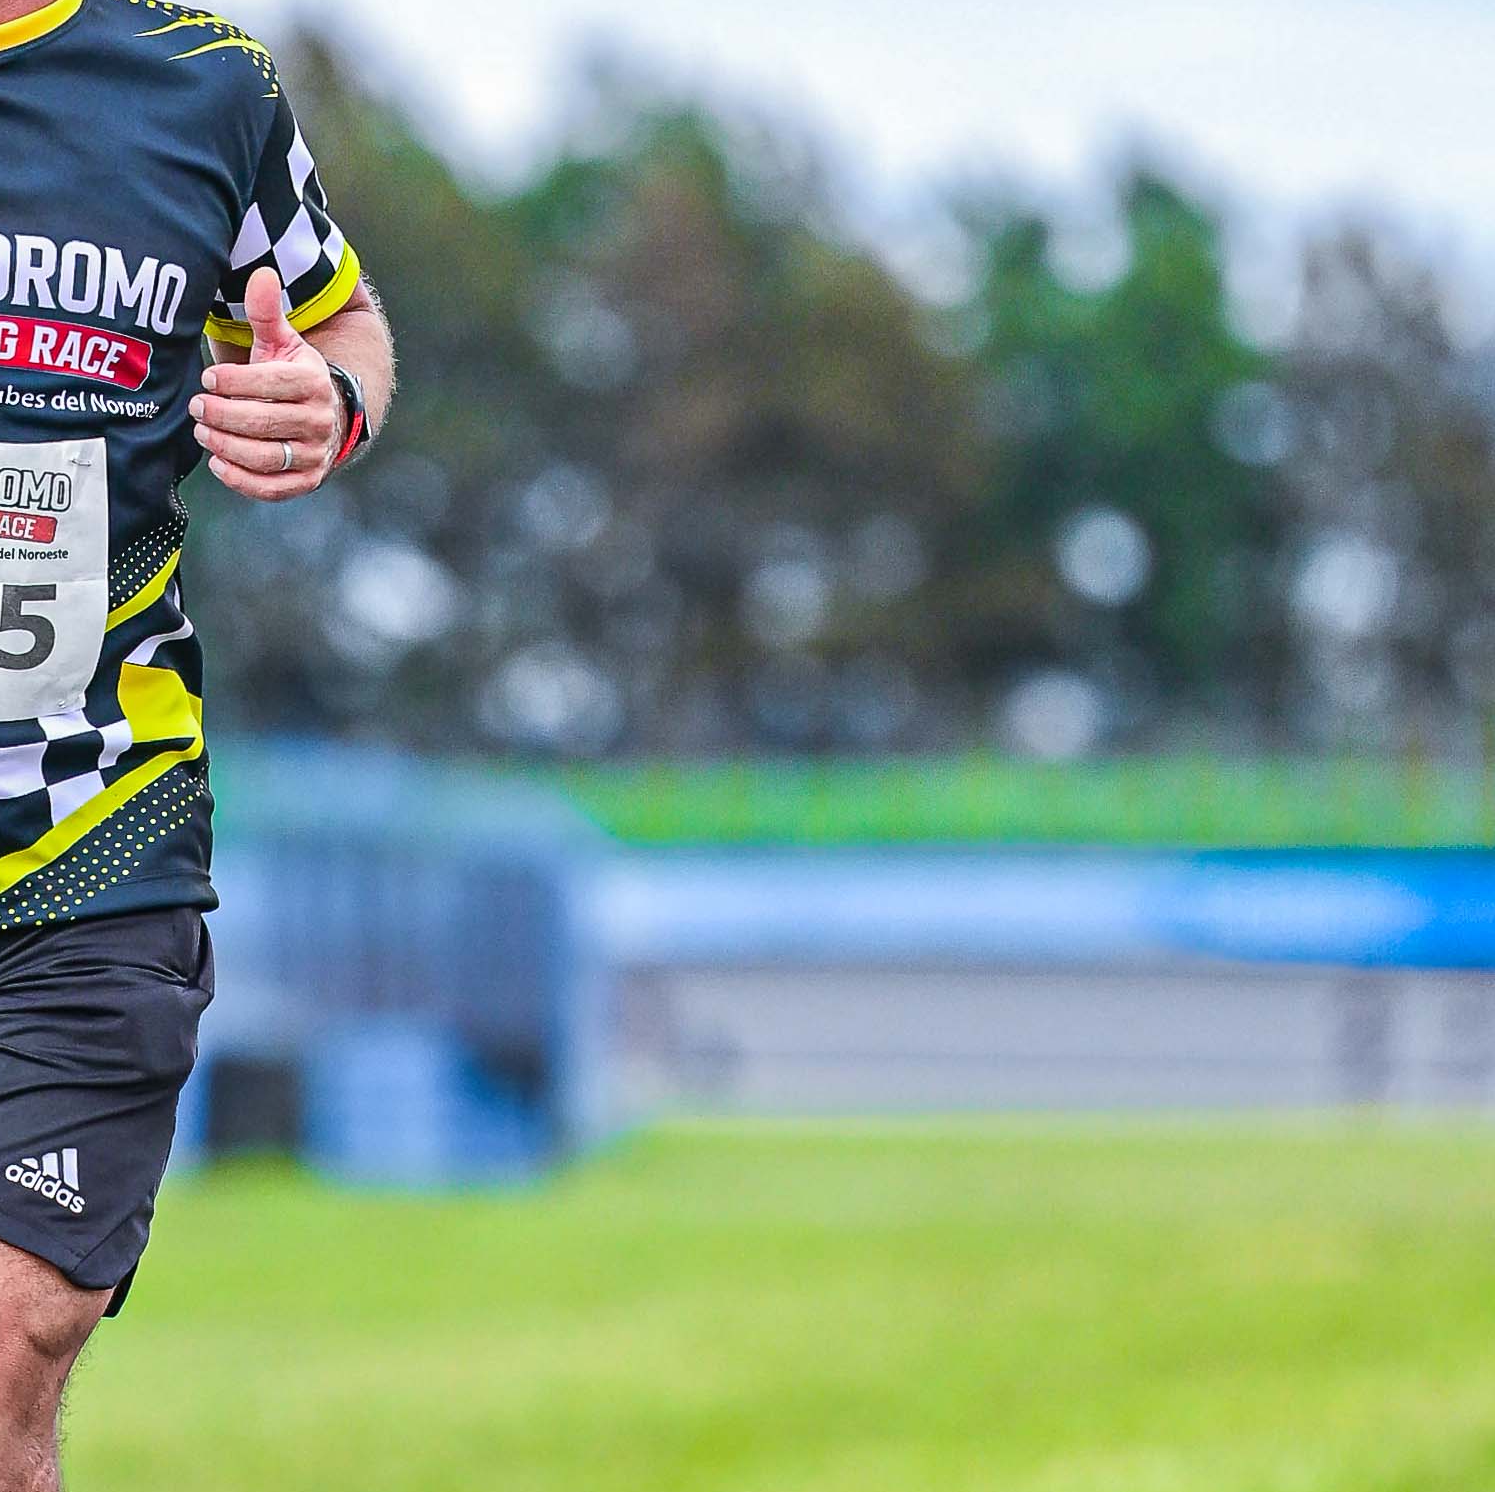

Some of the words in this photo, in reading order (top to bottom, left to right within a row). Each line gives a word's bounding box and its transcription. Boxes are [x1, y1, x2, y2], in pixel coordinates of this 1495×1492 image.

[28, 324, 128, 379] RACE
[50, 390, 86, 412] del
[18, 548, 69, 561] Noroeste
[5, 1164, 85, 1214] adidas
